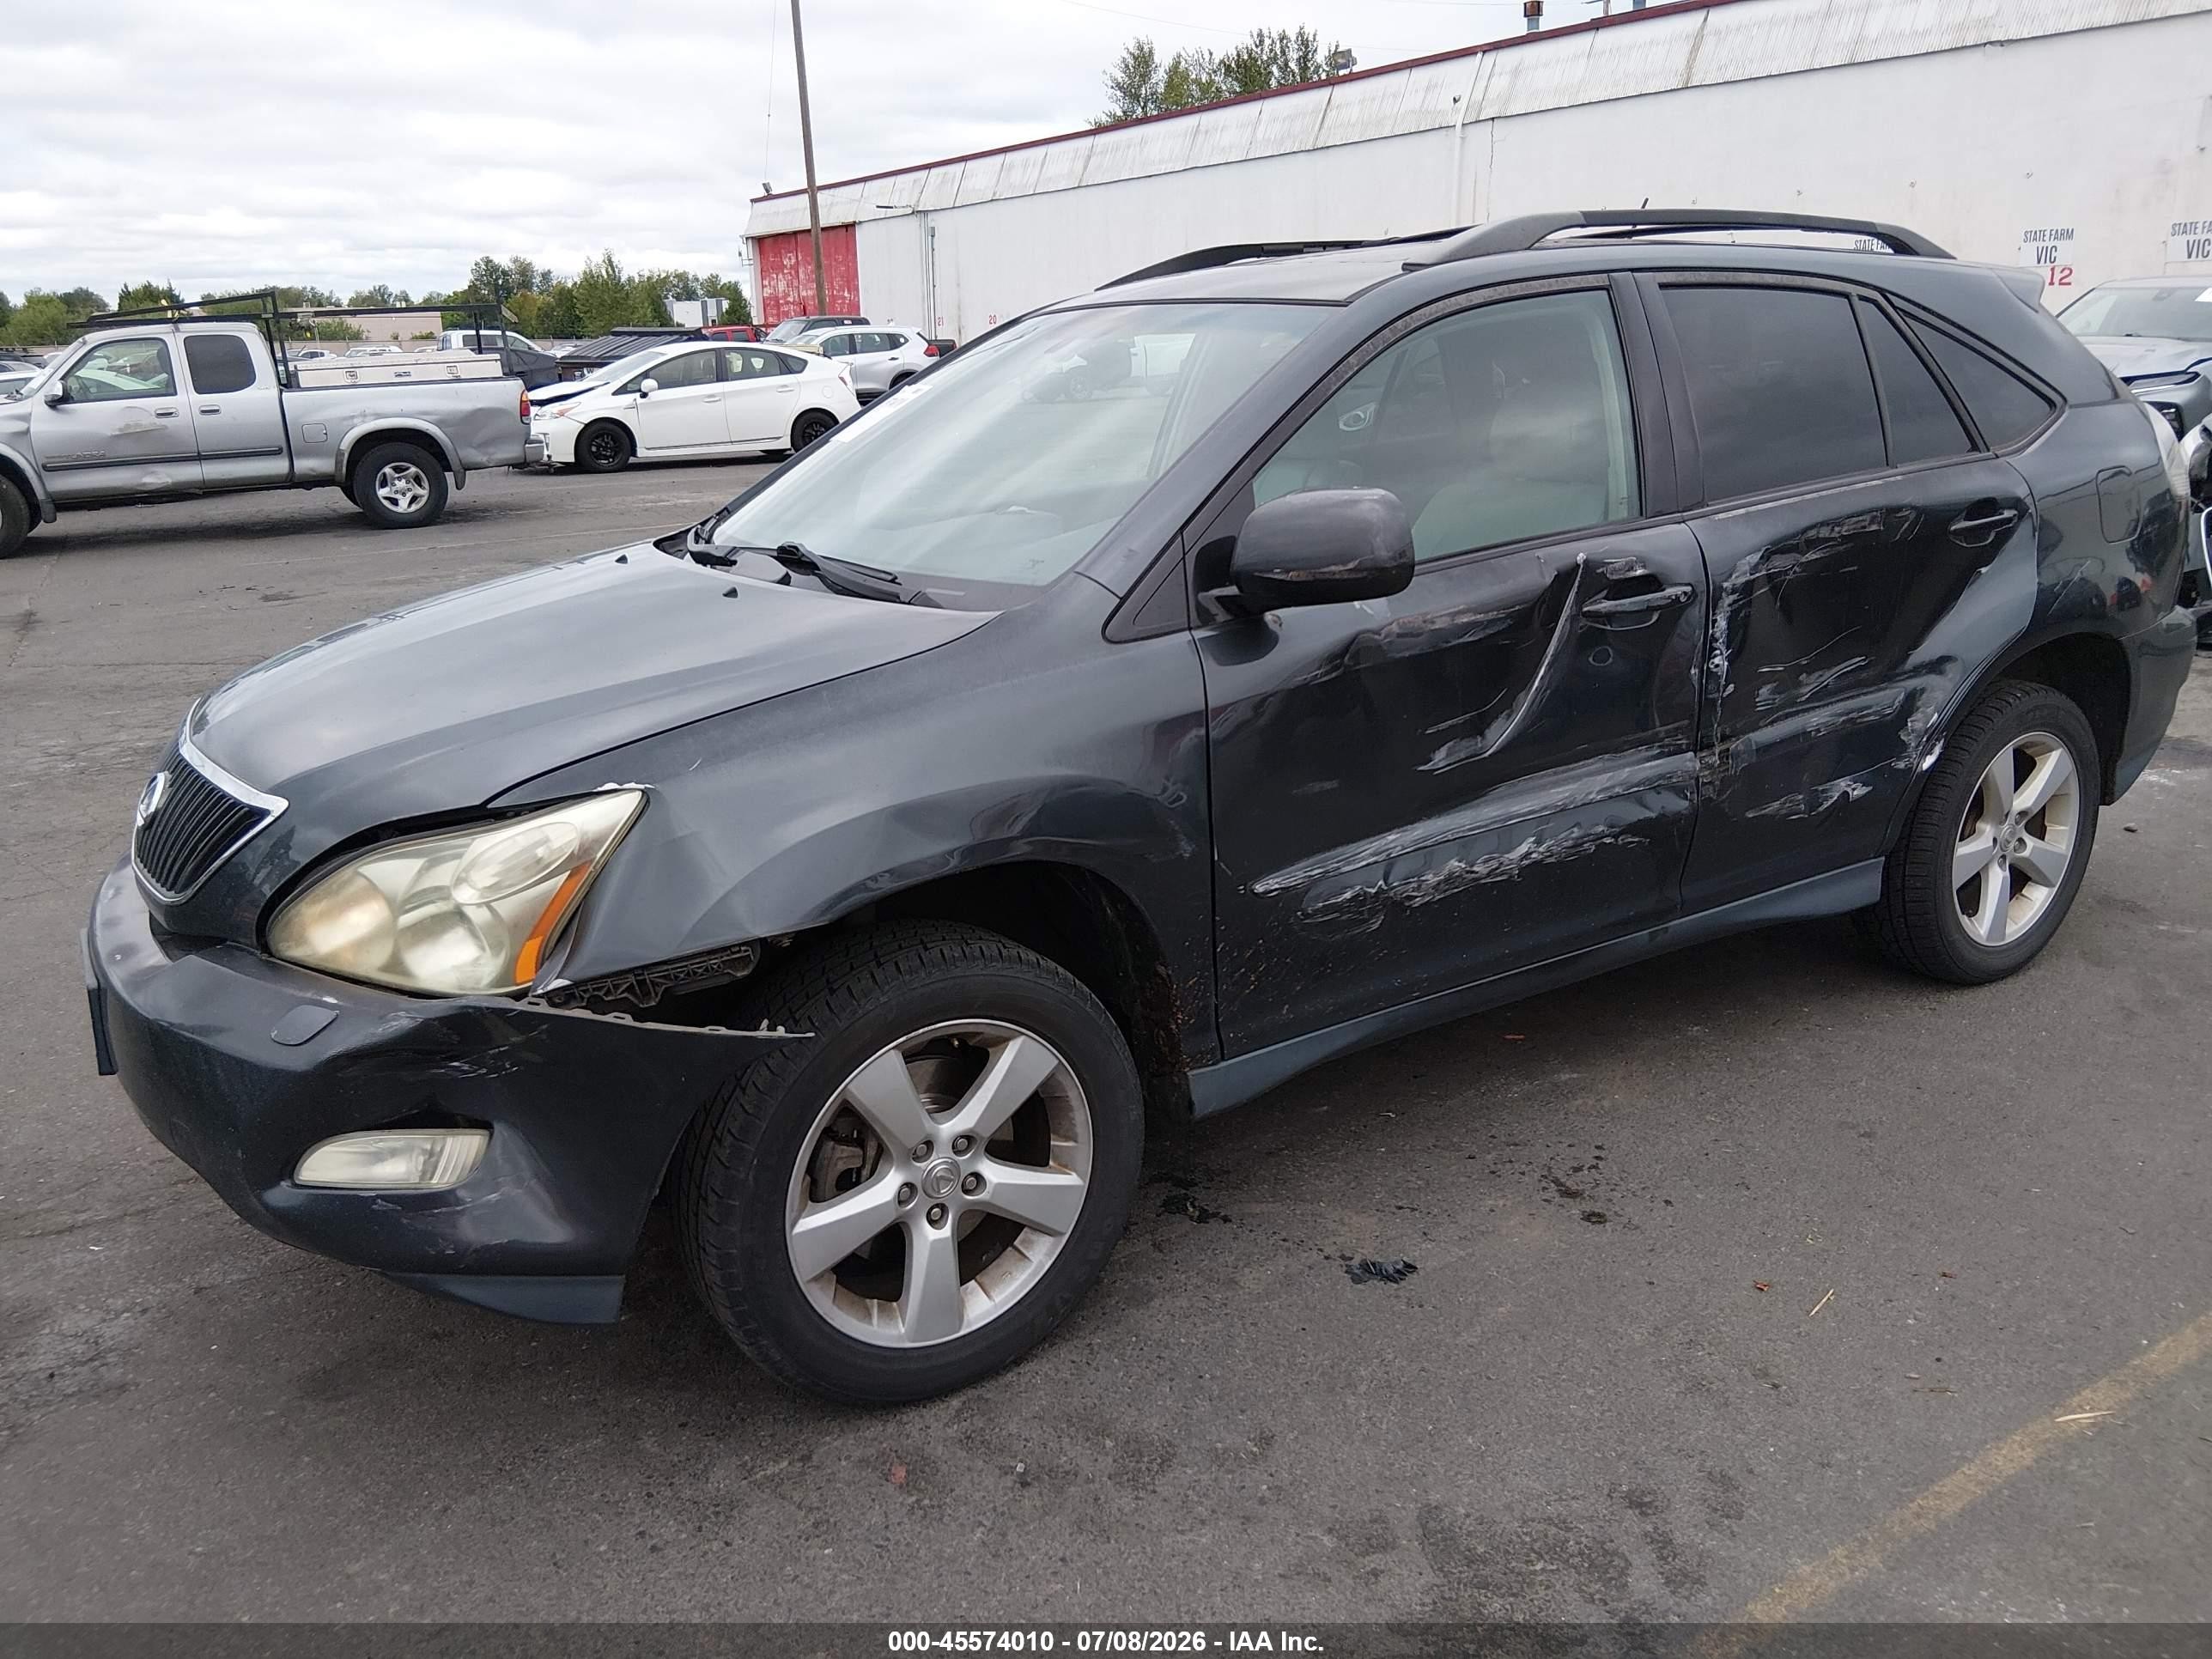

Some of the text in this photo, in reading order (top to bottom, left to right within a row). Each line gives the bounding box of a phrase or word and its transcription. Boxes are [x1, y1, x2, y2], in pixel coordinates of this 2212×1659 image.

[2023, 228, 2074, 243] STATE FARM
[2171, 221, 2199, 236] STATE
[1854, 239, 1875, 251] STATE
[2186, 238, 2211, 259] VIC
[2036, 245, 2057, 264] VIC
[2048, 266, 2073, 286] 12
[988, 314, 997, 325] 20
